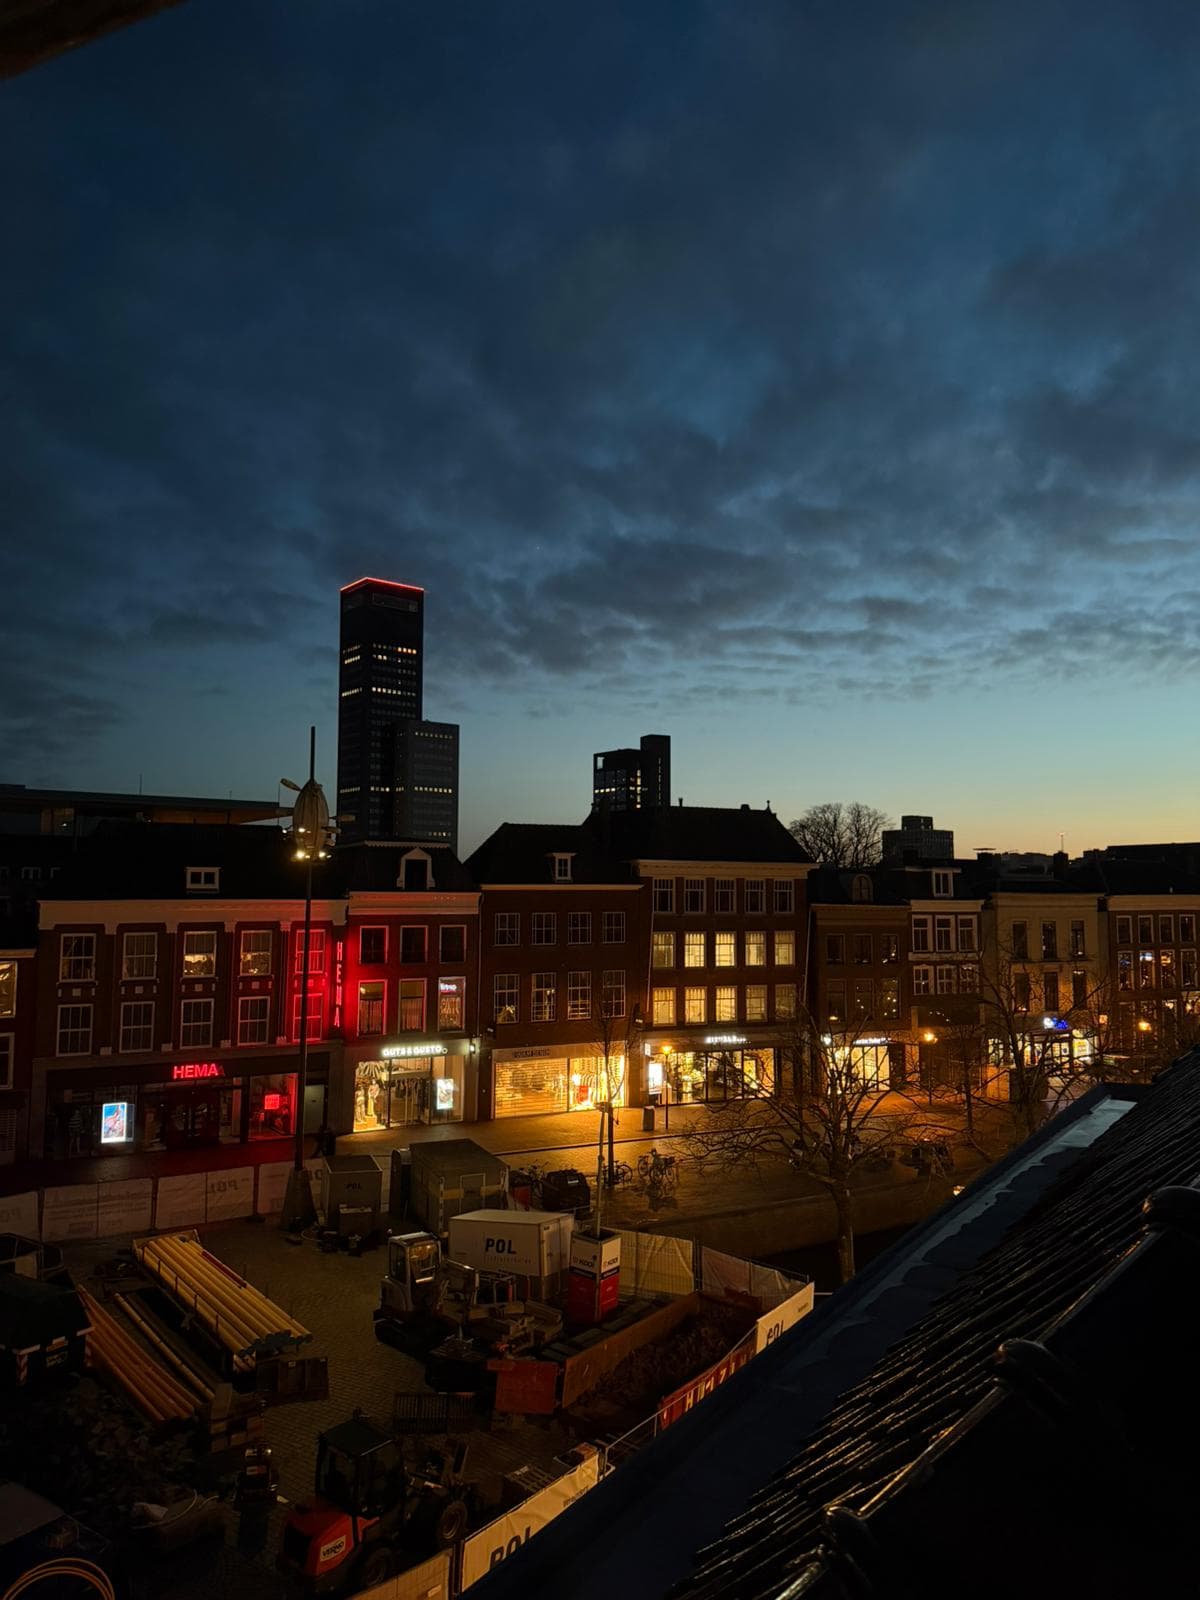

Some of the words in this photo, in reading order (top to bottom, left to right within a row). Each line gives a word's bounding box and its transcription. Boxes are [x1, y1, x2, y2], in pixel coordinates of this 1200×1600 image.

[334, 940, 343, 1028] HEMA
[172, 1062, 219, 1080] HEMA
[484, 1237, 517, 1255] POL
